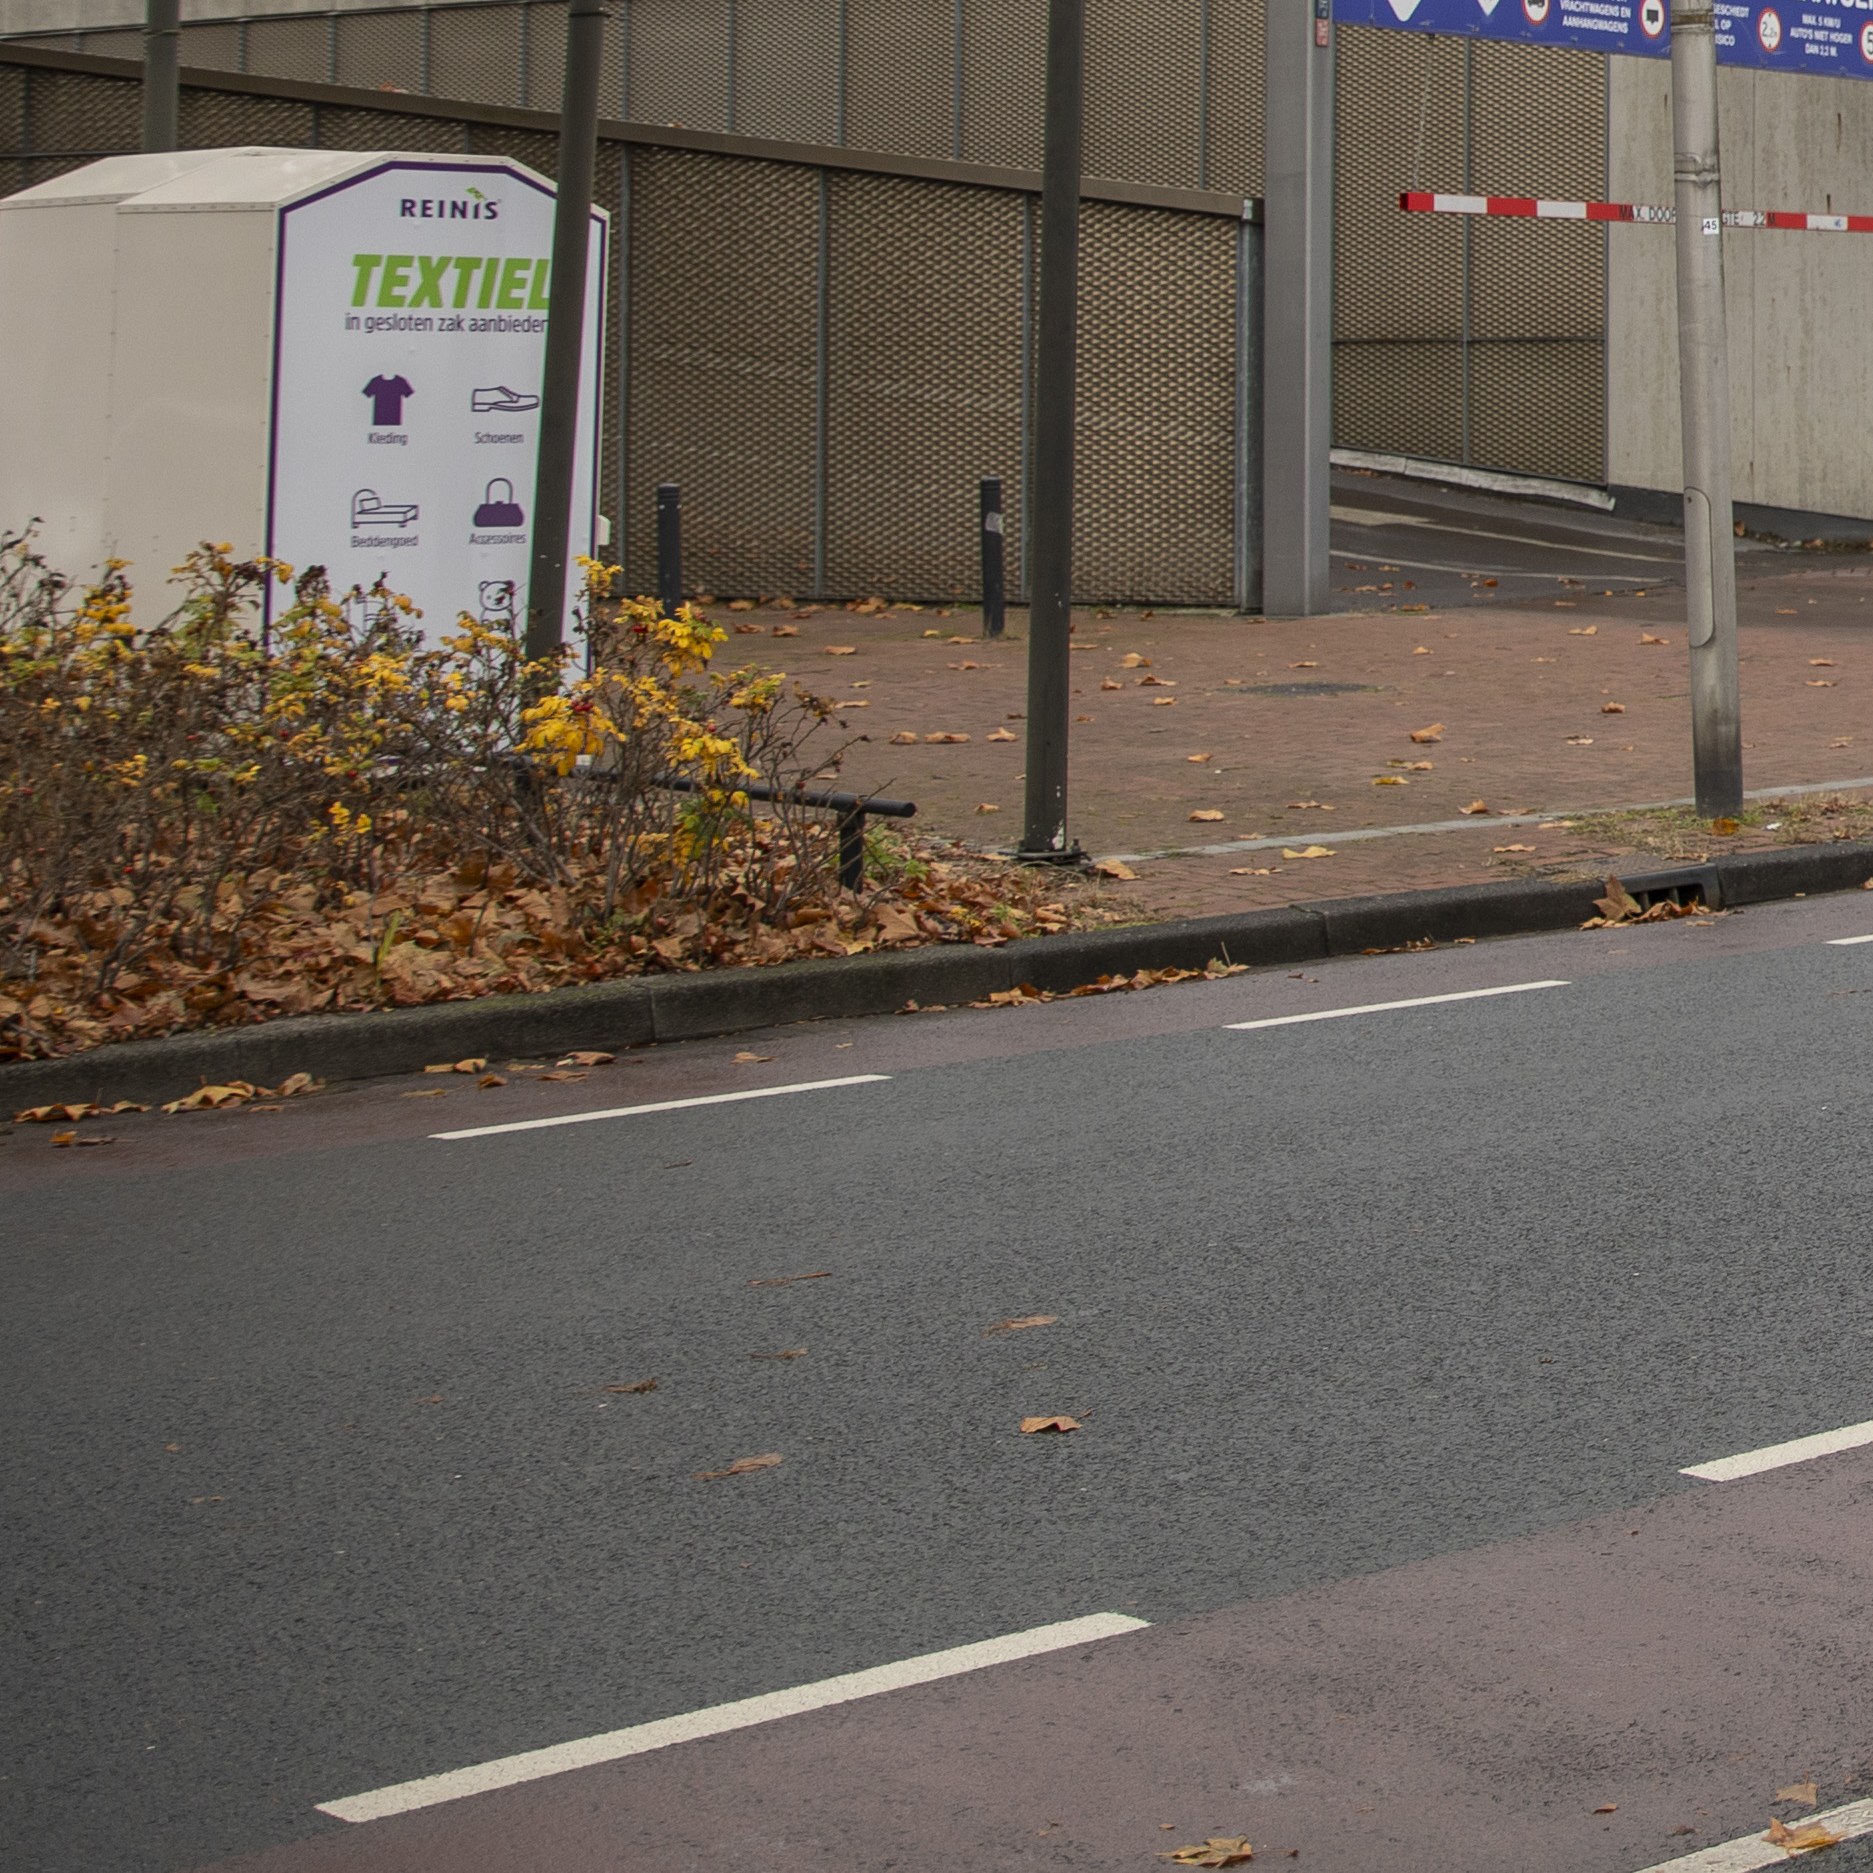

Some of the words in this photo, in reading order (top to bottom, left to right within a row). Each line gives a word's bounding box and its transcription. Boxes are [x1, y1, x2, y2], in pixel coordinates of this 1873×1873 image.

[1560, 0, 1620, 18] VRACHTWAGENS
[1562, 15, 1629, 34] AANHANGWAGENS
[400, 198, 499, 220] REINIS
[1704, 220, 1717, 230] 45
[351, 253, 550, 311] TEXTIEL
[345, 313, 360, 330] in
[364, 313, 433, 333] gesloten
[437, 315, 465, 332] zak
[368, 432, 408, 446] Kleding
[474, 432, 524, 444] Schoenen
[351, 535, 419, 548] Beddengoed
[468, 533, 527, 545] Accessoires
